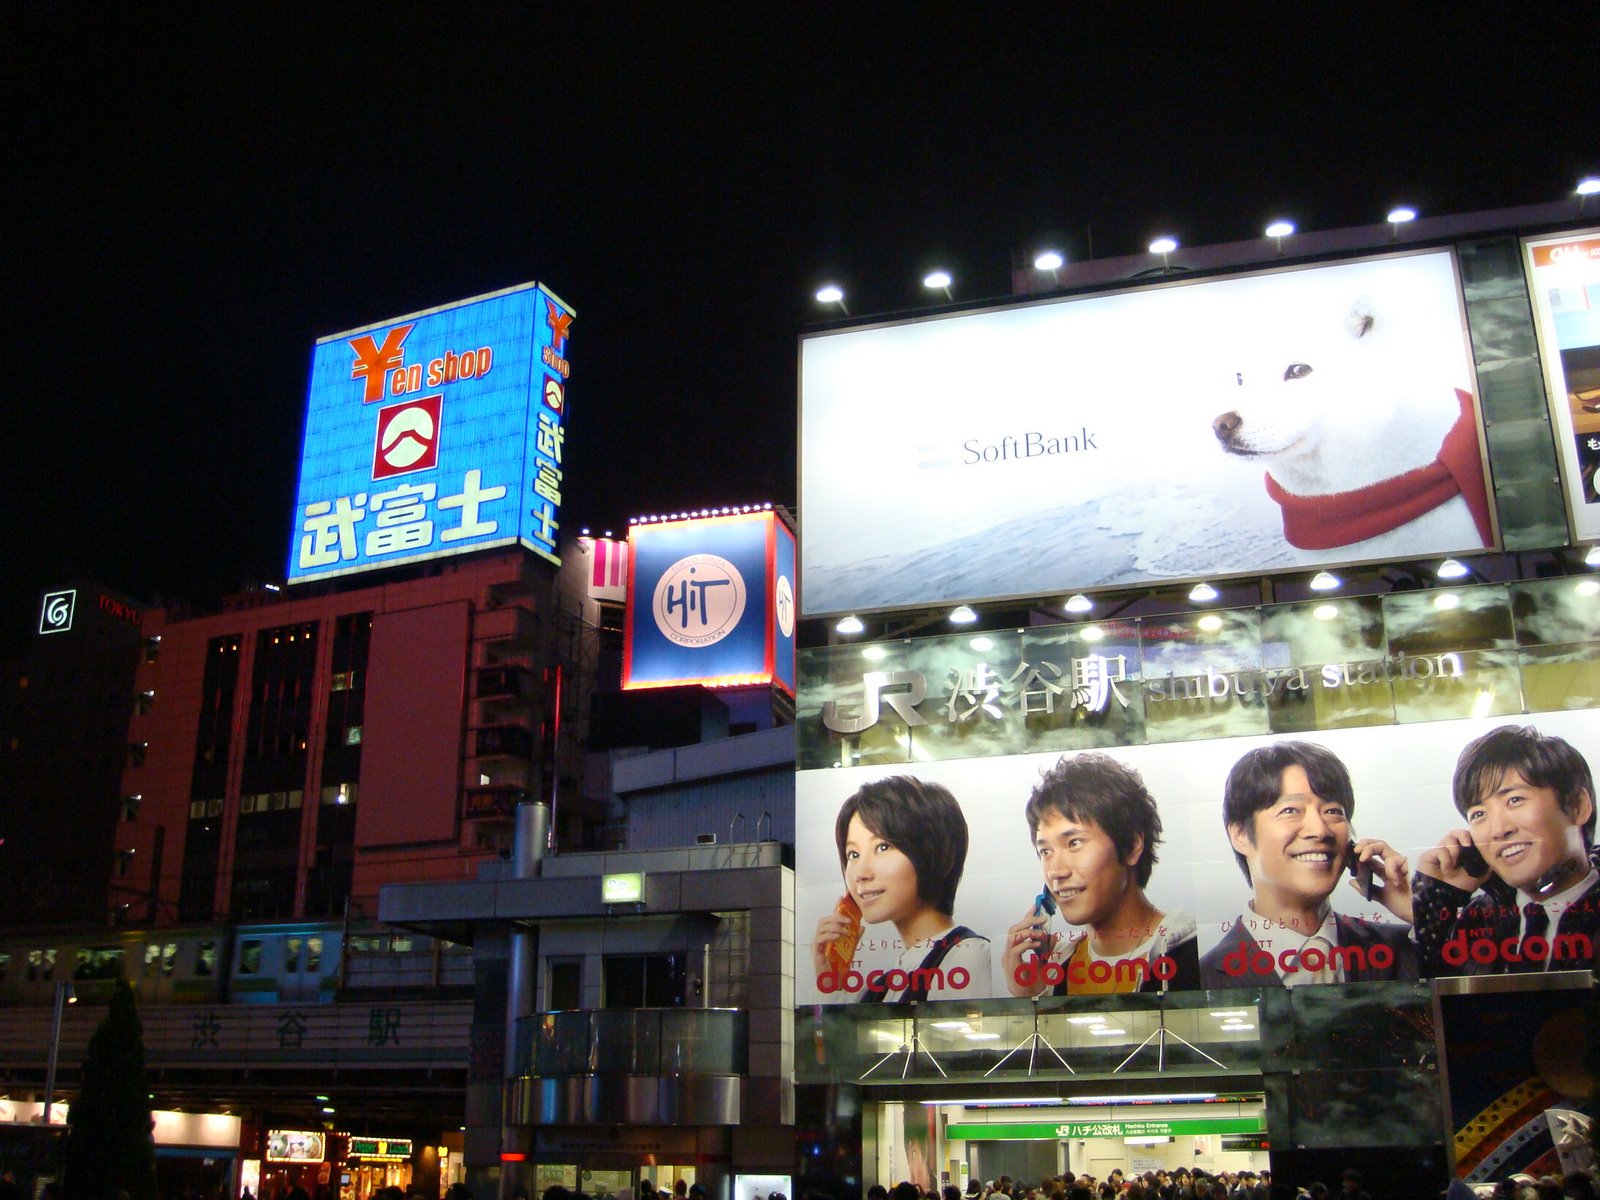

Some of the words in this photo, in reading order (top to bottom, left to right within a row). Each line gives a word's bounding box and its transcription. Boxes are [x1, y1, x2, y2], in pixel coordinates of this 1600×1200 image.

[428, 346, 493, 387] shop
[963, 427, 1099, 465] SoftBank
[532, 412, 565, 549] 武富士
[299, 469, 506, 570] 武富士
[672, 557, 698, 572] TOKYO
[701, 556, 727, 569] GINZA
[97, 594, 144, 626] TOKYU
[670, 629, 727, 645] CORPORATION
[944, 654, 1133, 723] 渋谷駅
[1149, 663, 1308, 702] shibuya
[1321, 651, 1463, 689] station
[823, 671, 928, 735] JR
[1469, 928, 1495, 938] NTT
[1014, 953, 1177, 987] docomo
[1222, 940, 1394, 977] docomo
[816, 960, 970, 994] docomo
[192, 1007, 401, 1049] 渋谷駅
[355, 1141, 376, 1152] Pepper
[389, 1142, 409, 1153] Lunch
[1056, 1125, 1070, 1136] JR
[1072, 1124, 1123, 1136] ハチ公改札
